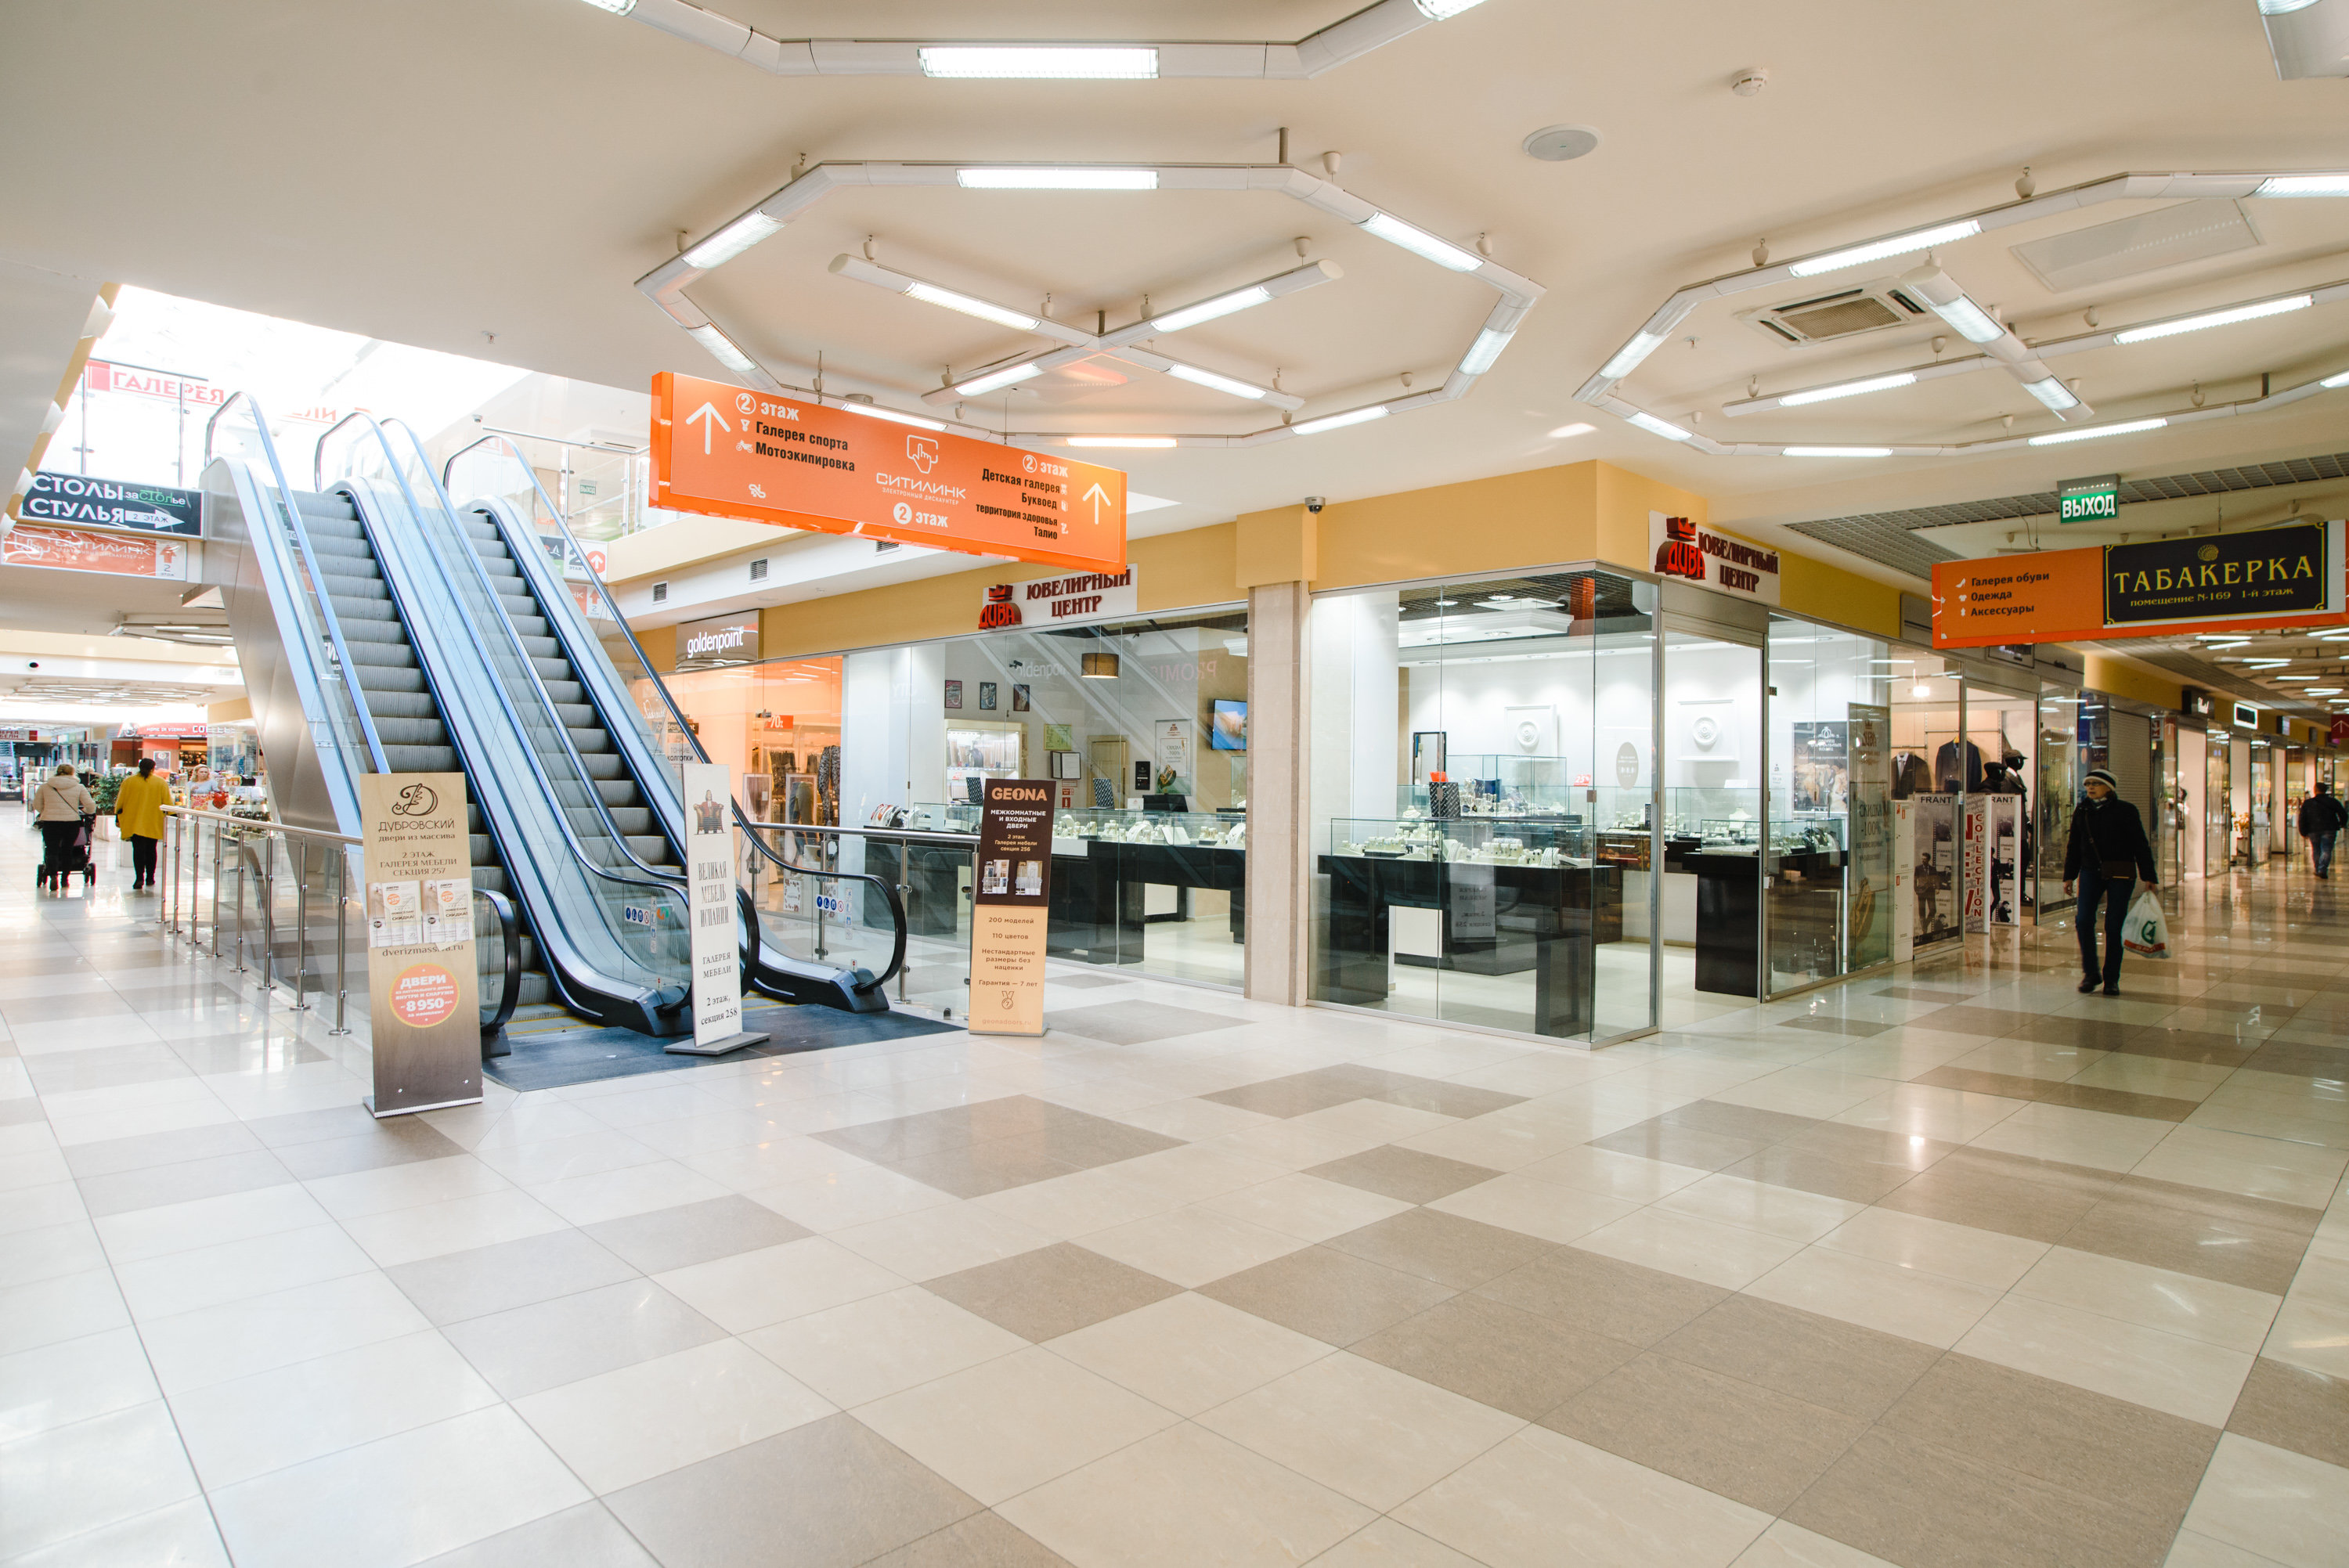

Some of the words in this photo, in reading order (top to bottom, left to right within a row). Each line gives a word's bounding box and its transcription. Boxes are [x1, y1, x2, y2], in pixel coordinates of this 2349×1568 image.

[760, 402, 799, 421] этаж
[756, 421, 805, 442] Галерея
[809, 434, 848, 450] спорта
[756, 442, 855, 472] Мотоэкипировка
[1040, 462, 1068, 478] этаж
[33, 474, 124, 501] СТОЛЫ
[876, 472, 966, 499] СИТИЛИНК
[982, 468, 1021, 486] Детская
[1024, 478, 1060, 494] галерея
[882, 487, 922, 499] ЭЛЕКТРОННЫЙ
[924, 495, 959, 505] ДИСКАУНТЕР
[1021, 492, 1057, 510] Буквоед
[29, 498, 124, 523] СТУЛЬЯ
[976, 503, 1021, 519] территория
[1022, 512, 1058, 526] здоровья
[2062, 494, 2115, 518] ВЫХОД
[144, 514, 168, 523] ЭТАЖ
[915, 511, 948, 528] этаж
[1034, 526, 1058, 539] Талио
[1698, 532, 1778, 575] ЮВЕЛИРНЫЙ
[1027, 565, 1131, 600] ЮВЕЛИРНЫЙ
[1719, 564, 1759, 593] ЦЕНТР
[1972, 575, 2013, 586] Галерея
[2016, 572, 2050, 584] обуви
[2113, 555, 2314, 593] ТАБАКЕРКА
[1971, 591, 2012, 601] Одежда
[2130, 595, 2194, 607] помещение
[2242, 589, 2259, 599] 1-й
[2261, 587, 2294, 597] этаж
[1051, 595, 1102, 619] ЦЕНТР
[1971, 604, 2034, 617] Аксессуары
[687, 626, 744, 658] goldenpoint
[991, 787, 1047, 801] GEONA
[378, 818, 455, 832] ДУБРОВСКИЙ
[380, 860, 418, 868] ГАЛЕРЕЯ
[393, 868, 429, 877] СЕКЦИЯ
[698, 861, 727, 881] ВЕЛИКАЯ
[1974, 813, 1983, 917] COLLECTION
[701, 883, 727, 904] МЕБЕЛЬ
[700, 906, 729, 928] ИСПАНИИ
[382, 944, 464, 957] dverizmassa.ru
[702, 952, 731, 965] ГАЛЕРЕЯ
[400, 975, 446, 989] ДВЕРИ
[703, 966, 731, 979] МЕБЕЛИ
[706, 997, 711, 1007] 2
[713, 995, 731, 1005] этаж,
[701, 1013, 724, 1026] секция
[725, 1007, 738, 1019] 258
